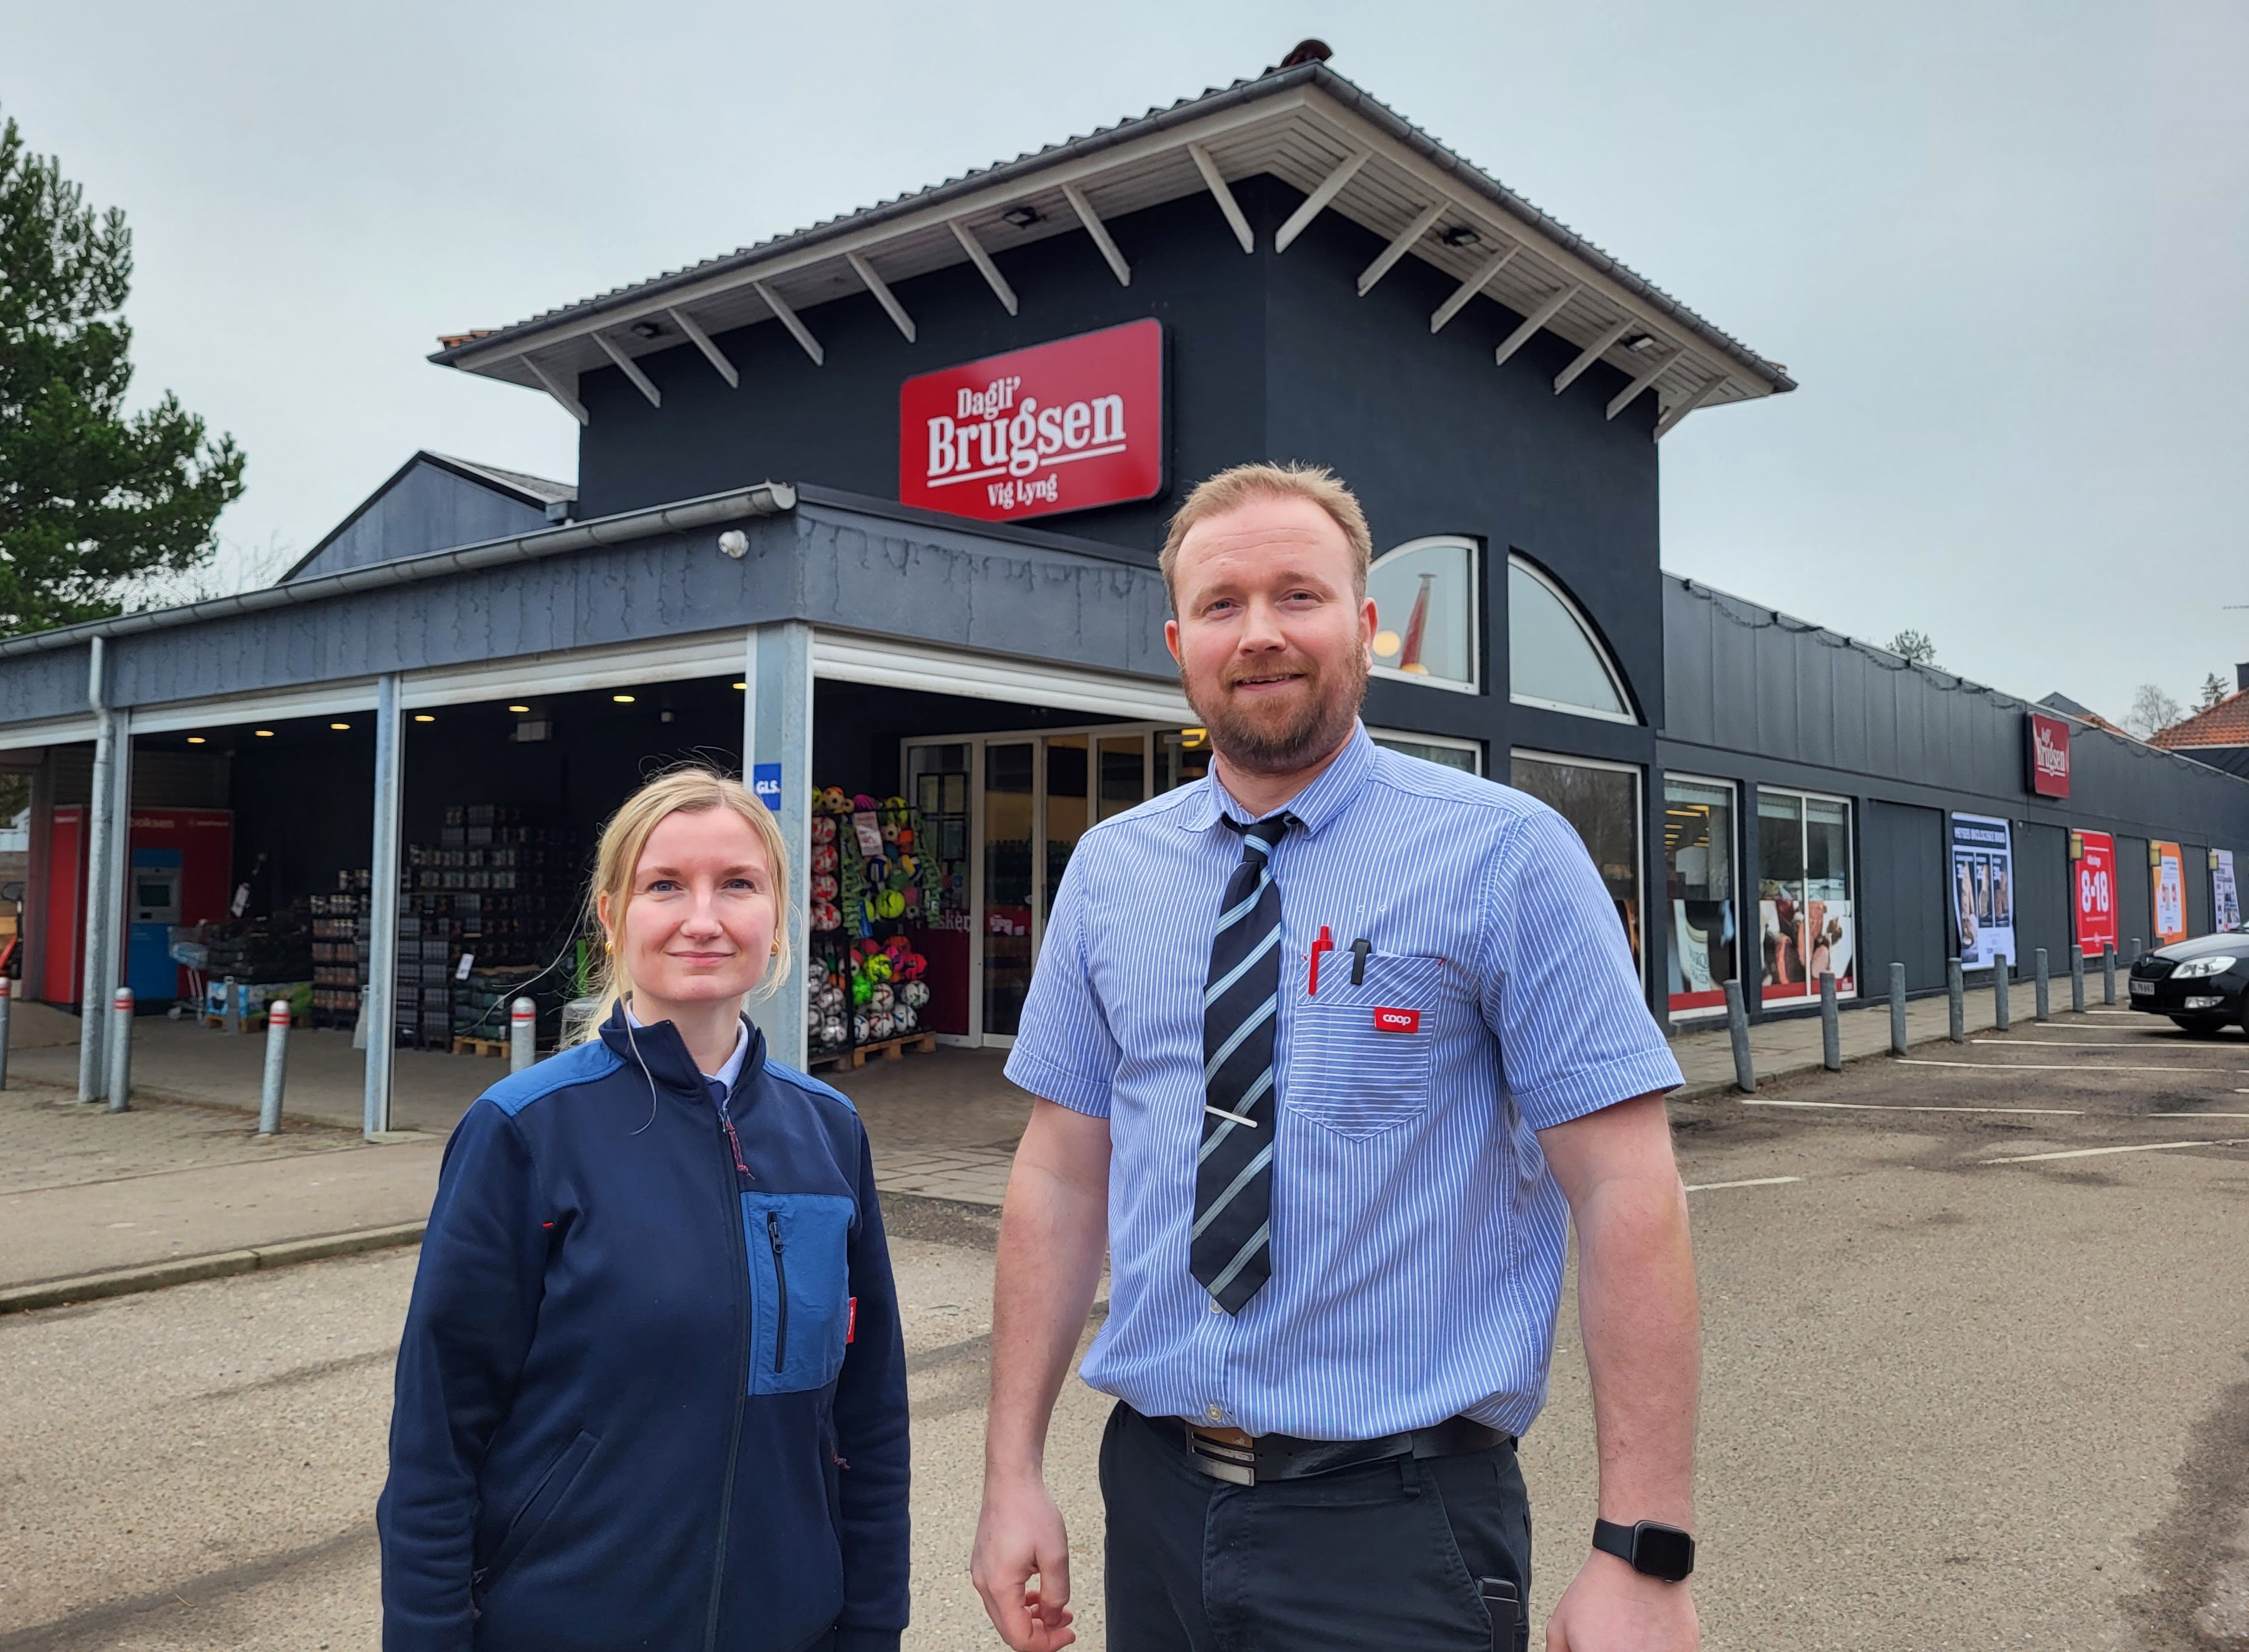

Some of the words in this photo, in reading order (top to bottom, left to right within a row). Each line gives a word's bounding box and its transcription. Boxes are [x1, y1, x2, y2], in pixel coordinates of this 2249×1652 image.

[957, 376, 1021, 420] Dagli'
[927, 394, 1126, 476] Brugsen
[988, 477, 1014, 509] Vig
[1016, 474, 1058, 506] Lyng
[2081, 870, 2109, 913] 8-18
[1383, 1014, 1412, 1025] coop
